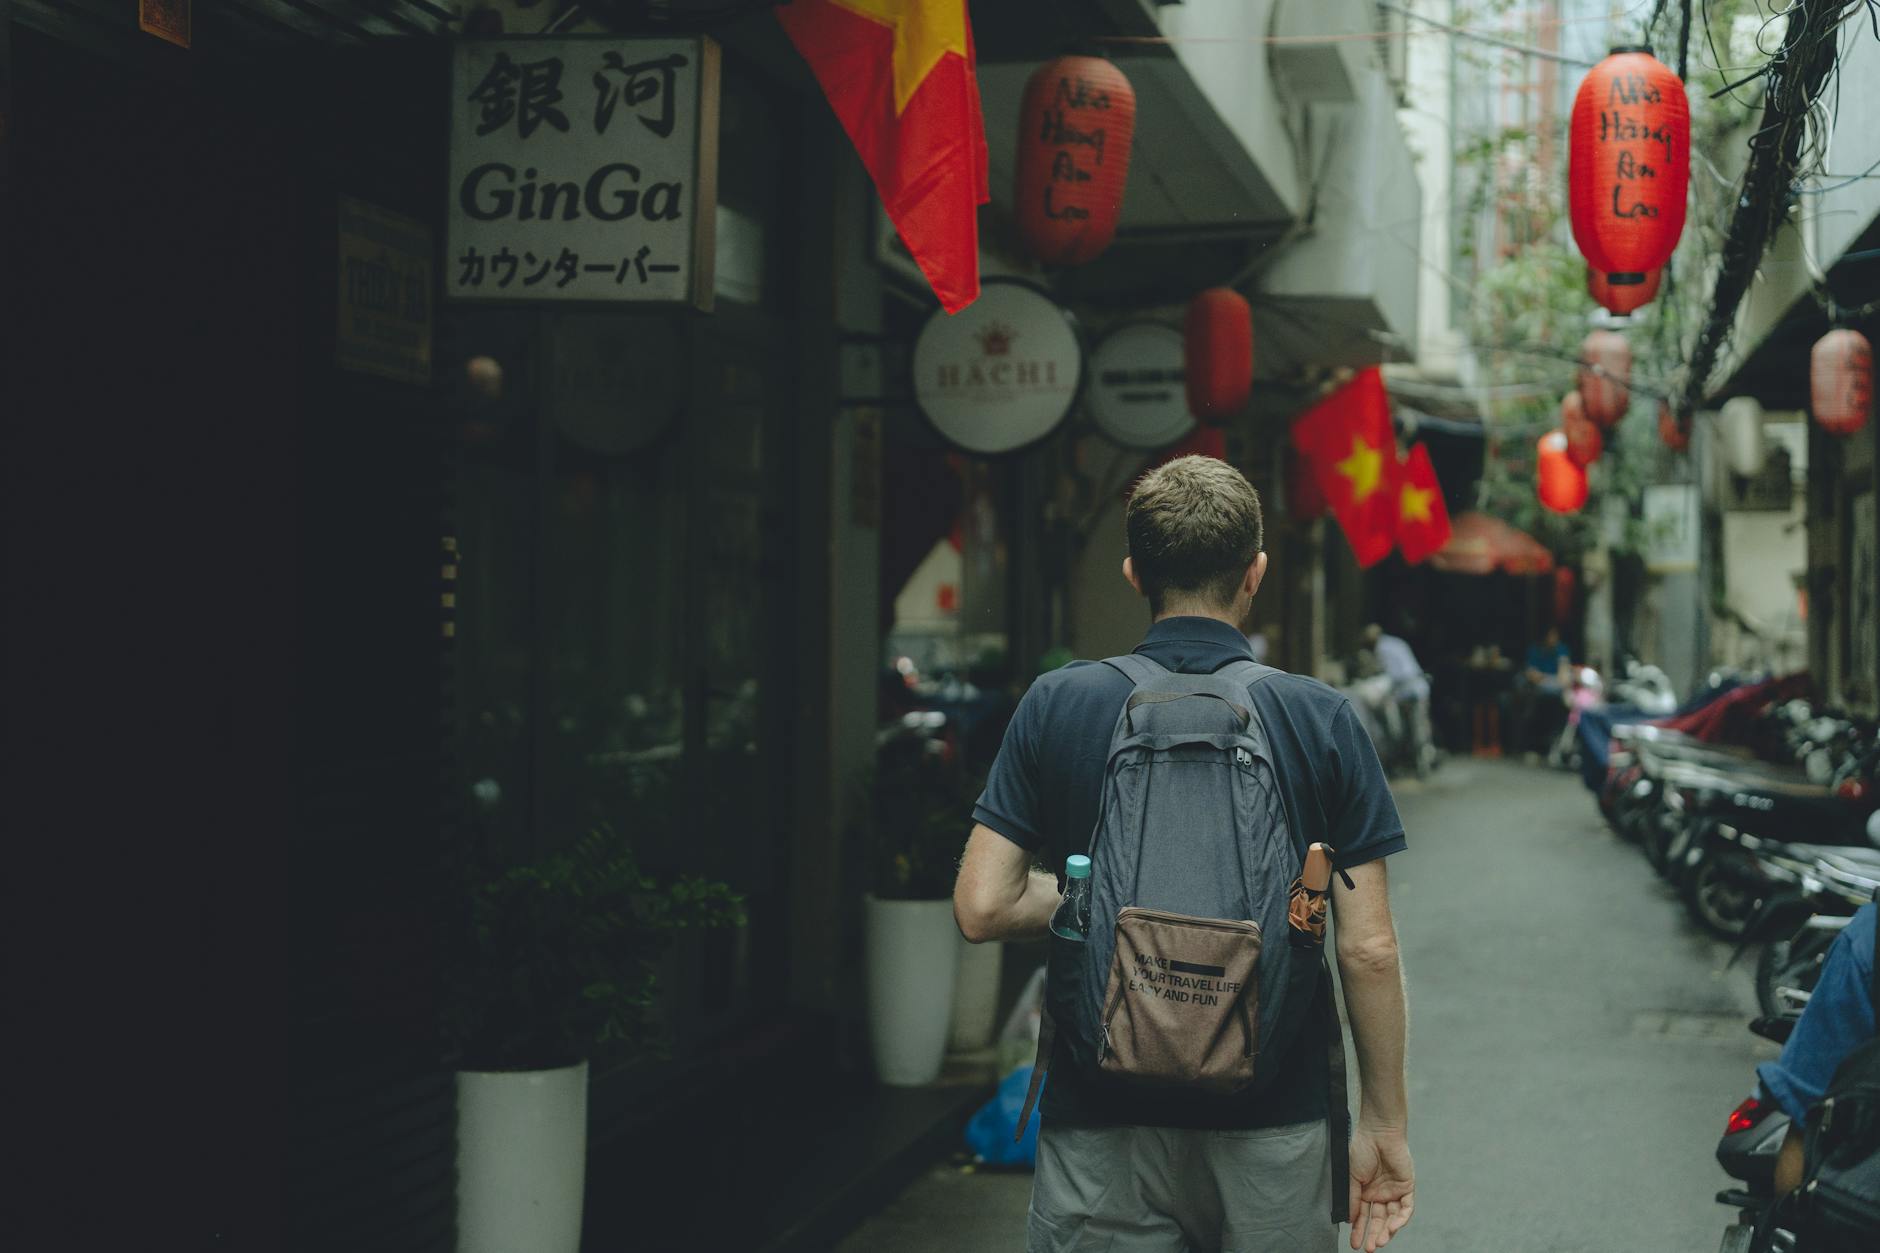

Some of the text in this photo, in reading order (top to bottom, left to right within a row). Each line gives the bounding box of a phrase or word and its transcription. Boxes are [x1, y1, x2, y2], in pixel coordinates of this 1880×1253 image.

[467, 51, 688, 139] 銀河
[460, 162, 682, 221] GinGa
[459, 246, 681, 288] カウンターバー
[938, 361, 1057, 388] HACHI
[1134, 952, 1168, 970] MAKE
[1133, 966, 1241, 993] YOUR TRAVEL LIFE
[1163, 989, 1189, 1003] AND
[1192, 993, 1219, 1007] FUN
